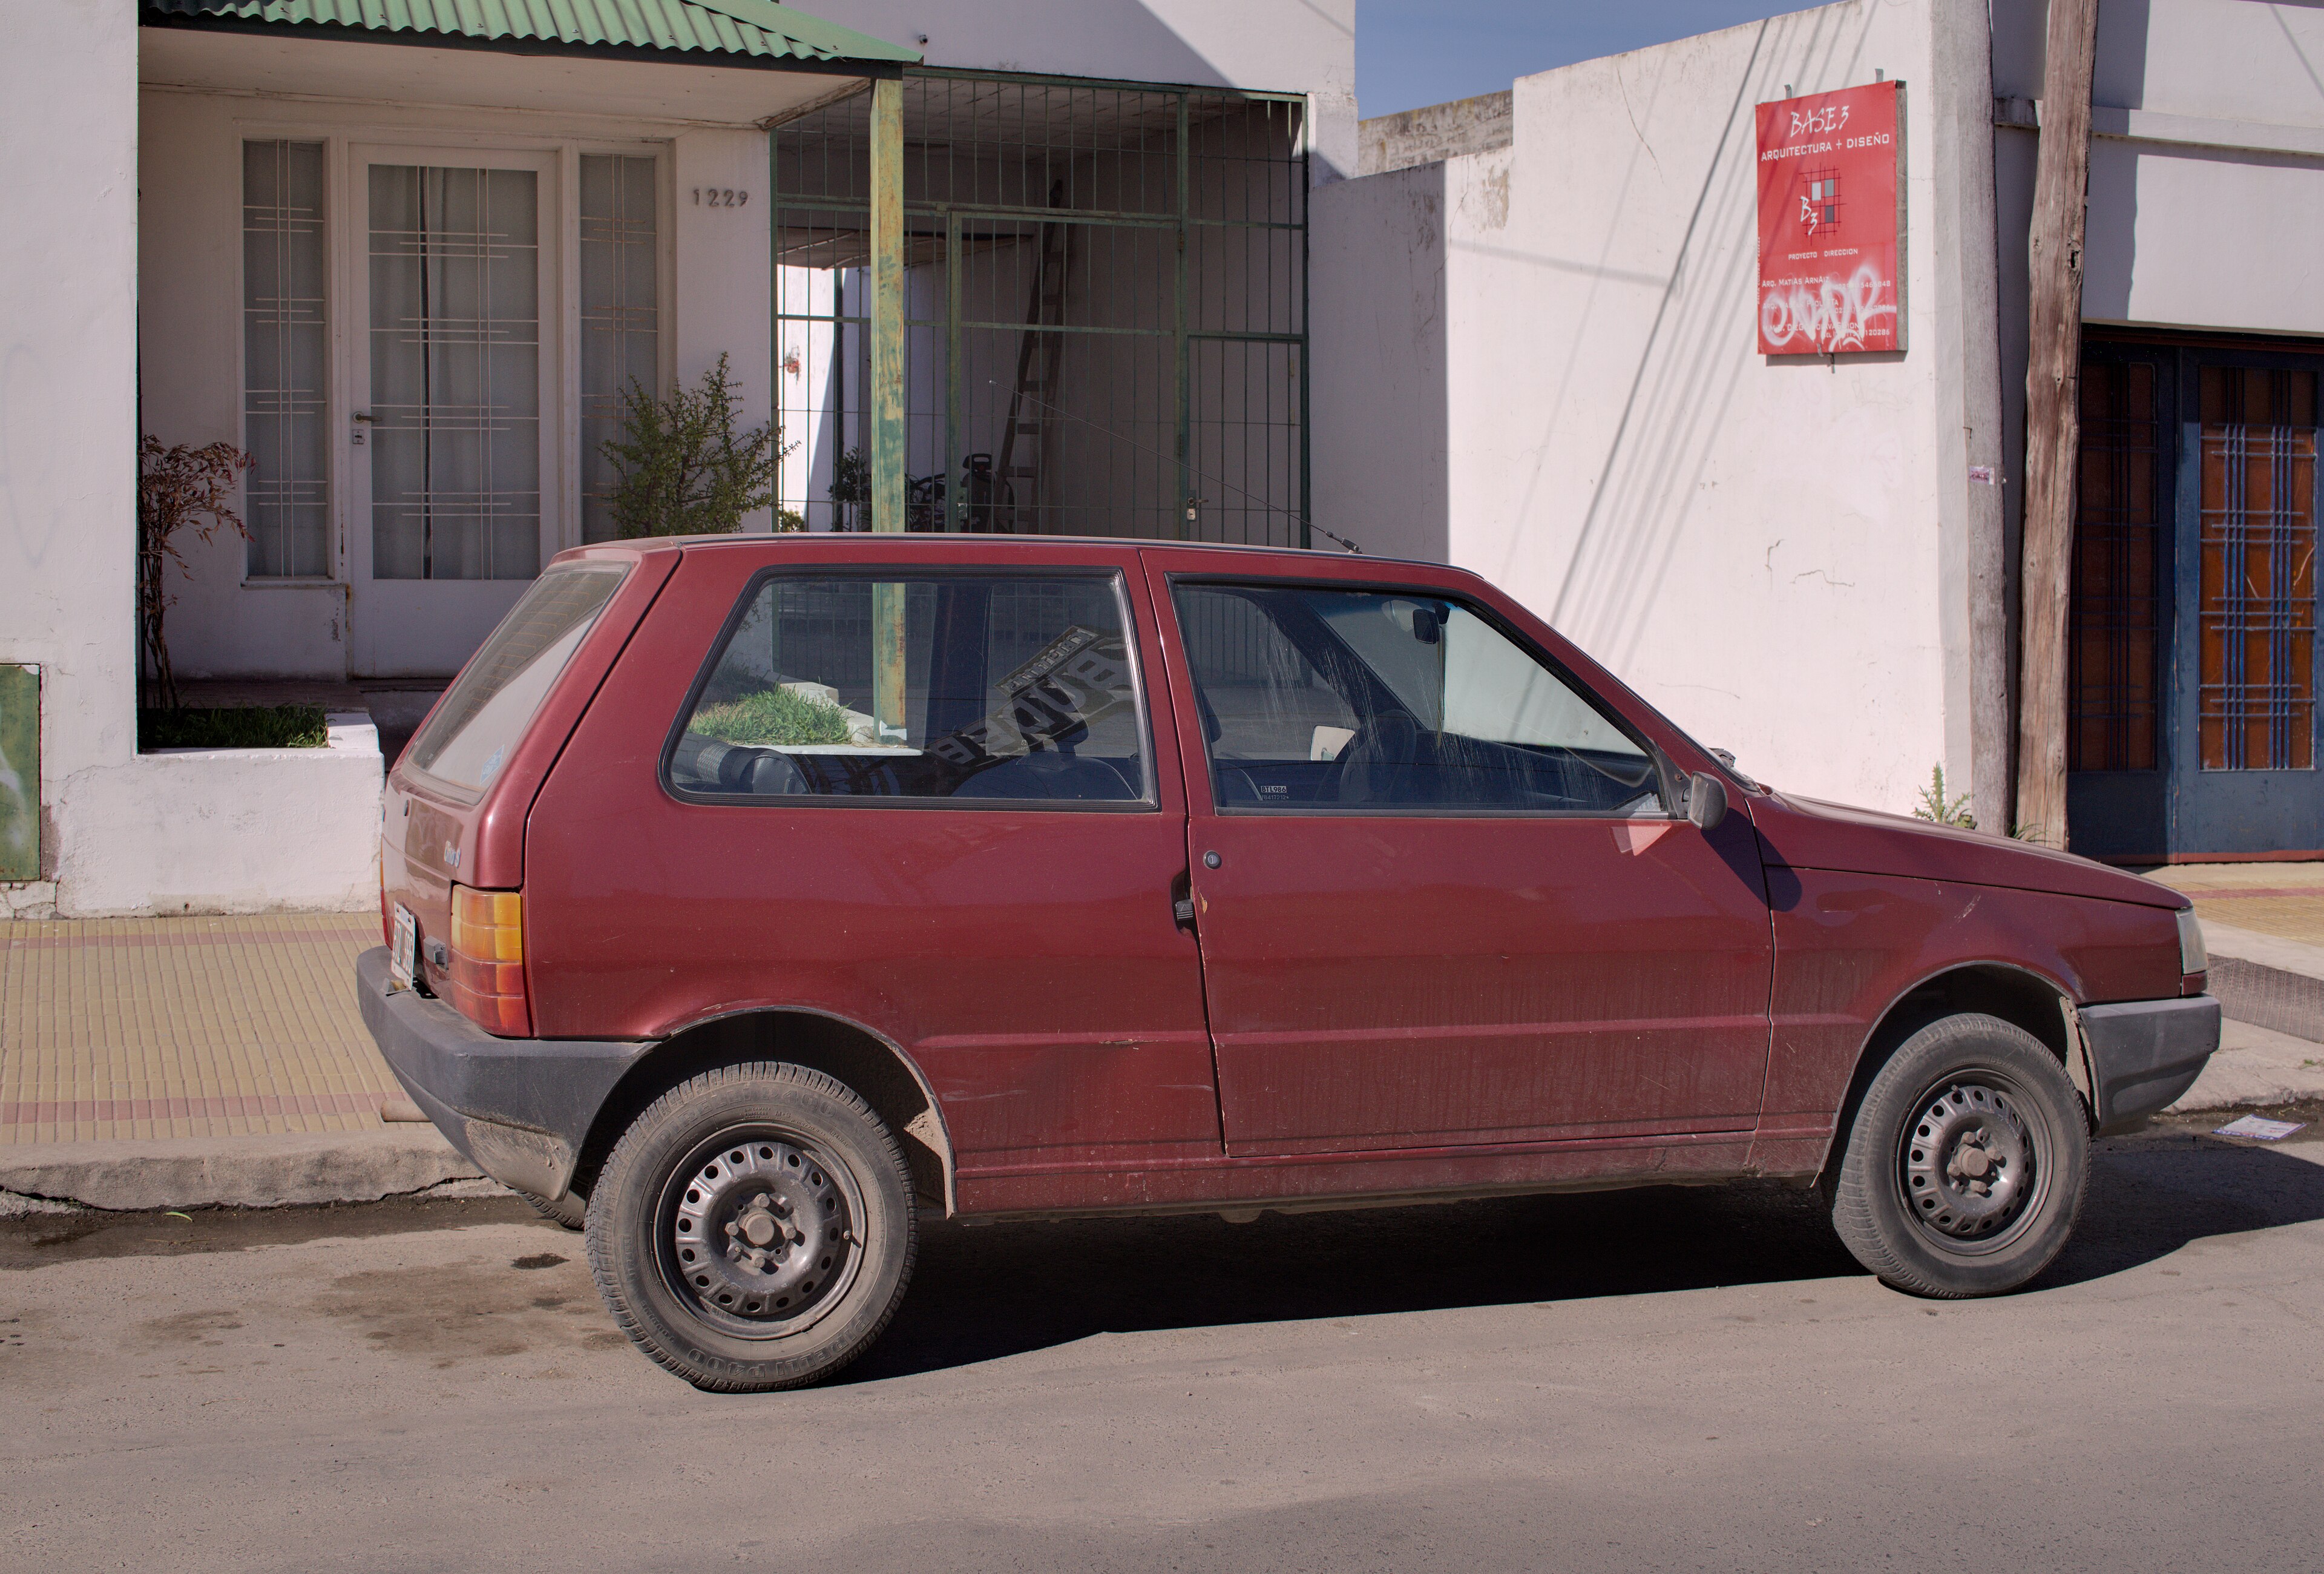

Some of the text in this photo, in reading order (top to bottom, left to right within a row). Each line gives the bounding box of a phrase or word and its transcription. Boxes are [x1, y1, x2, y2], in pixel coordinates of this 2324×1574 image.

[1790, 105, 1850, 138] BASE 3
[1761, 132, 1889, 162] ARQUITECTURA + DISEÑO
[694, 189, 748, 207] 1229
[1788, 248, 1858, 260] PROYECTO DIRECCION
[761, 1087, 838, 1118] P400
[688, 1348, 766, 1378] P400
